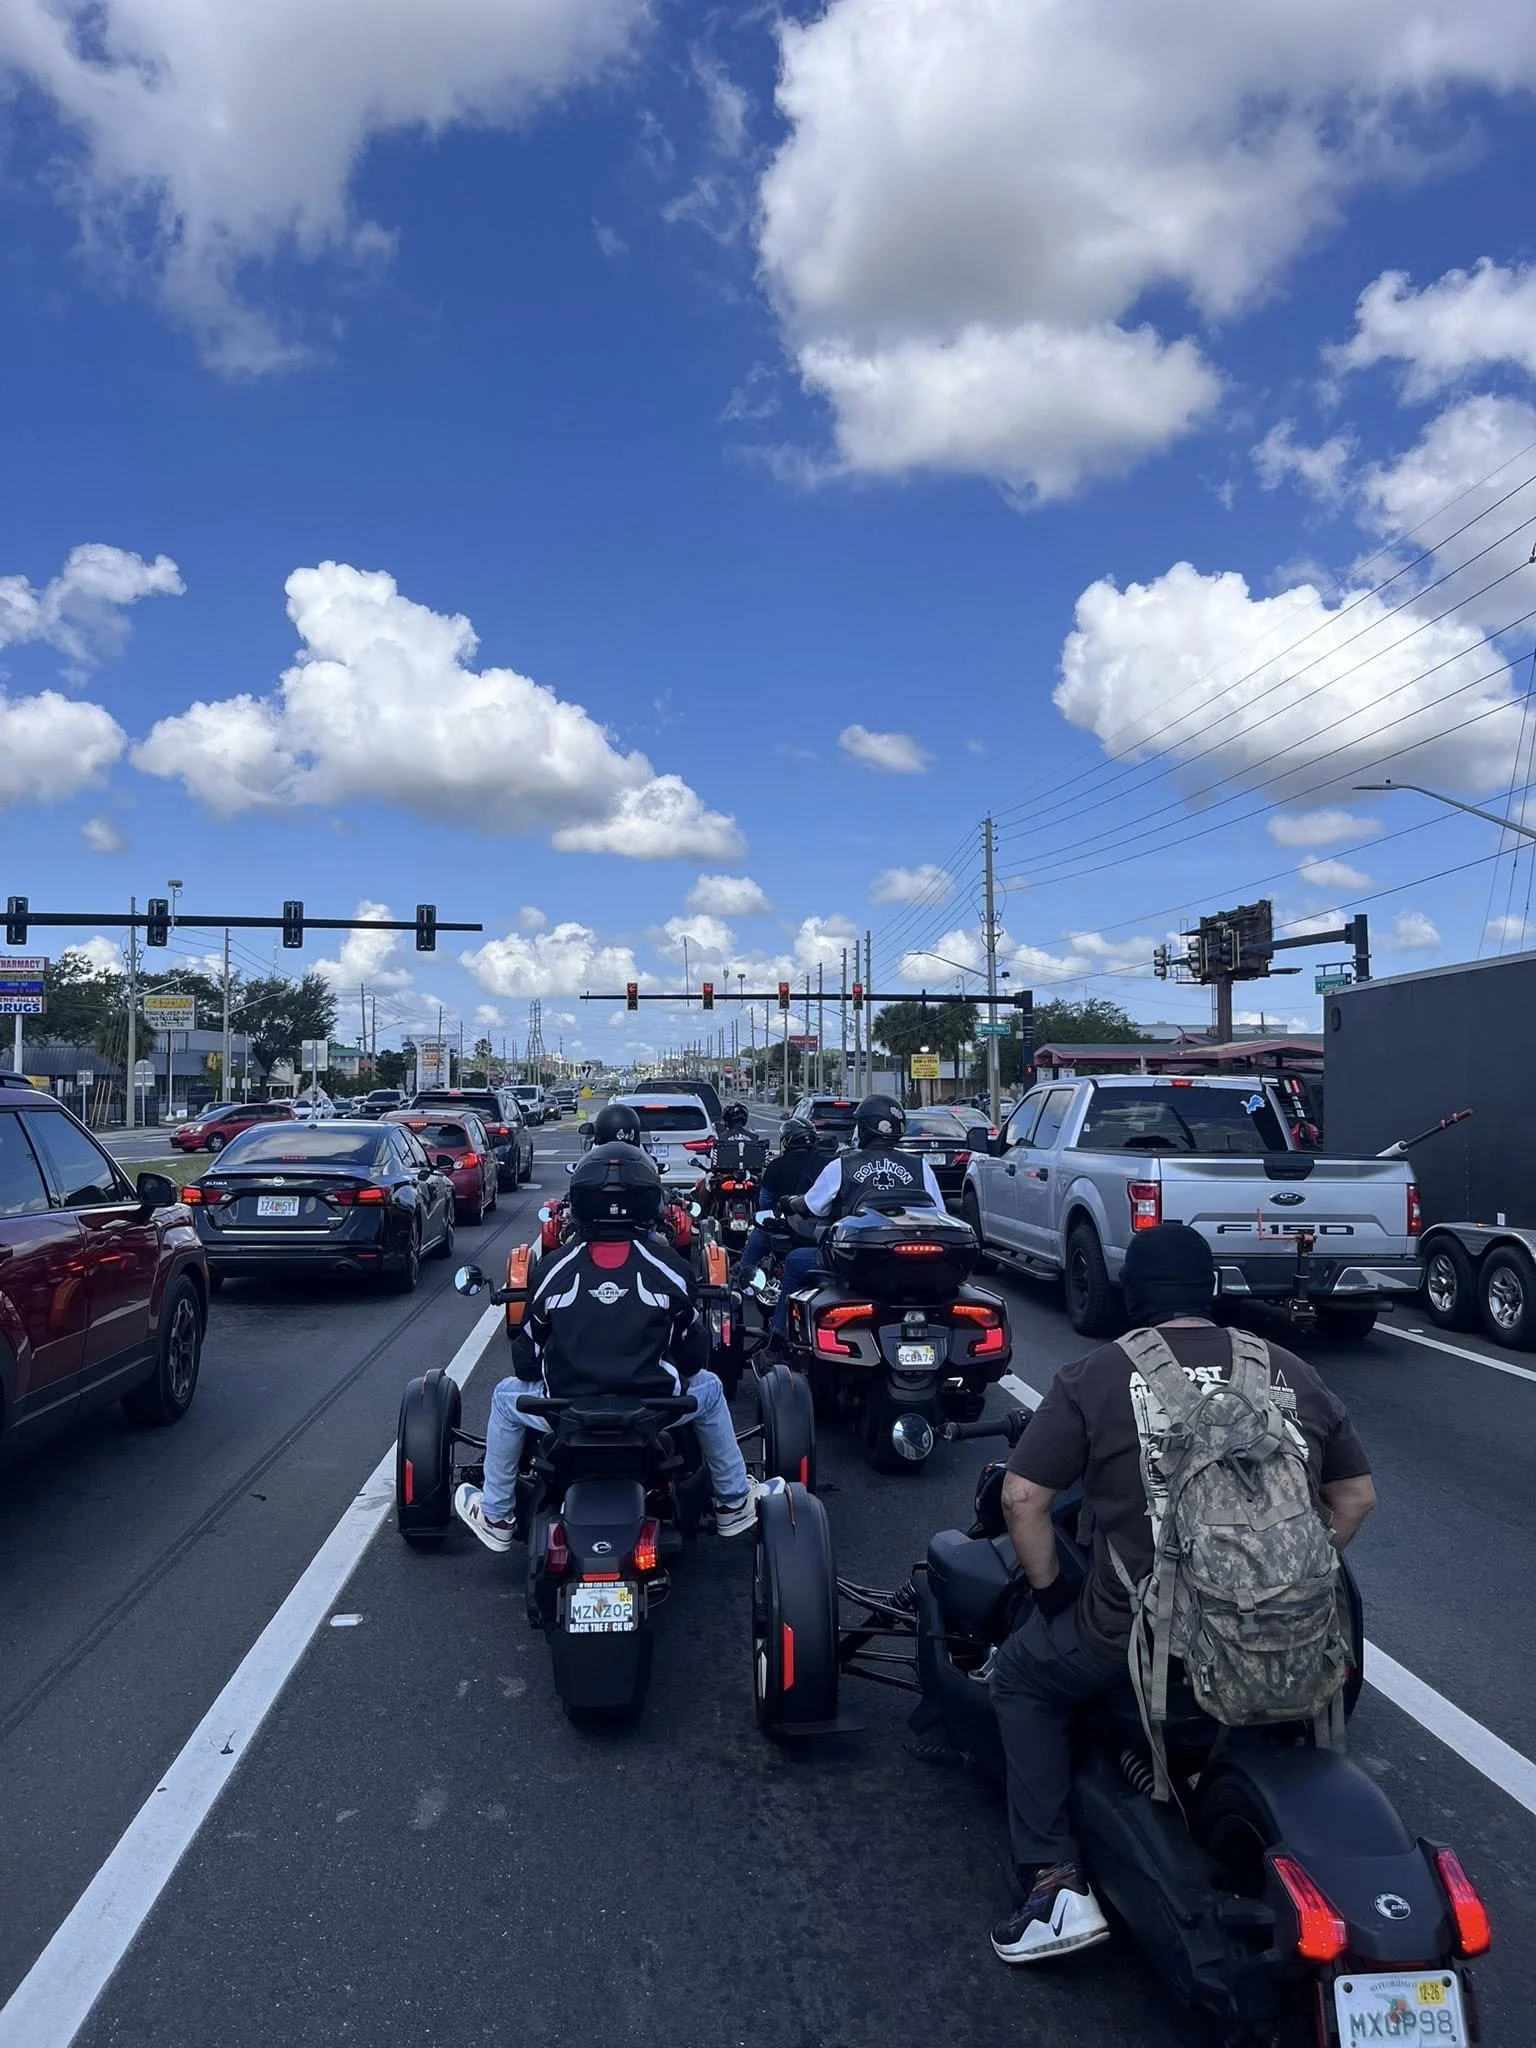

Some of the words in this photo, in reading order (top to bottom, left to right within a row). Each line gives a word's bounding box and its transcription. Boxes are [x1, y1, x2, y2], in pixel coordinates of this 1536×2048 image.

[0, 960, 40, 968] HARMACY
[0, 1003, 40, 1012] RUGS
[569, 1623, 590, 1633] BACK
[590, 1623, 604, 1632] THE
[623, 1622, 634, 1631] UP
